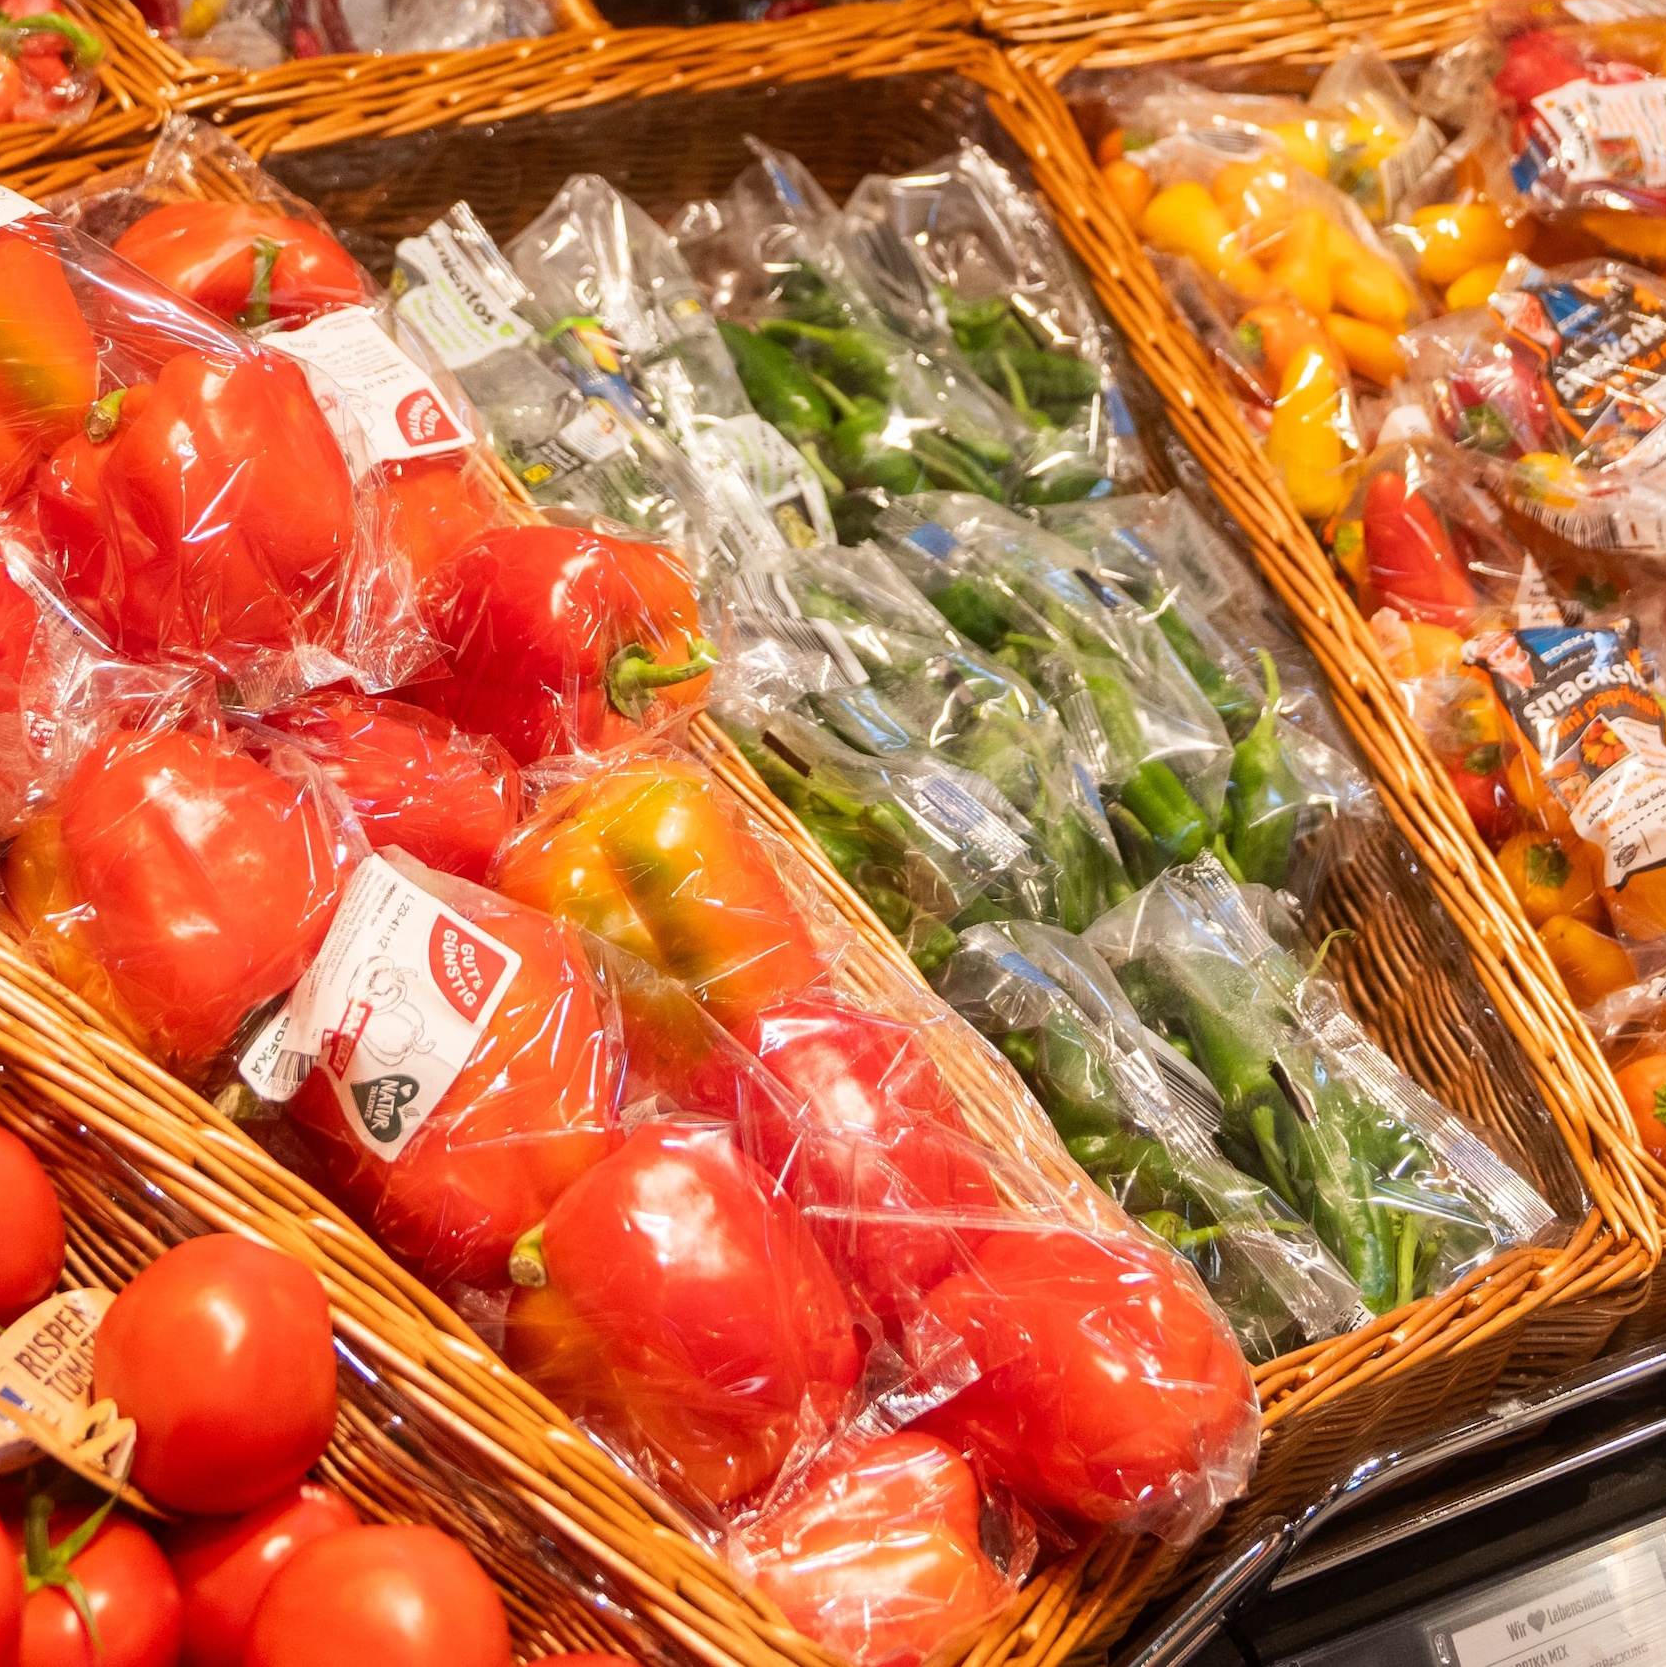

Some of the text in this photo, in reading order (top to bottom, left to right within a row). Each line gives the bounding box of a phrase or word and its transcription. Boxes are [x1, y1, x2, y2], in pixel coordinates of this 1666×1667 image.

[406, 394, 435, 442] GÜNSTIG
[441, 928, 479, 1008] GÜNSTIG
[460, 942, 485, 991] GUT&
[250, 1016, 291, 1076] EDEKA
[363, 1085, 380, 1122] TALENTE
[370, 1079, 401, 1131] NATUR
[1505, 1582, 1616, 1643] Wir Lebensmittel.
[1547, 1644, 1570, 1665] MIX
